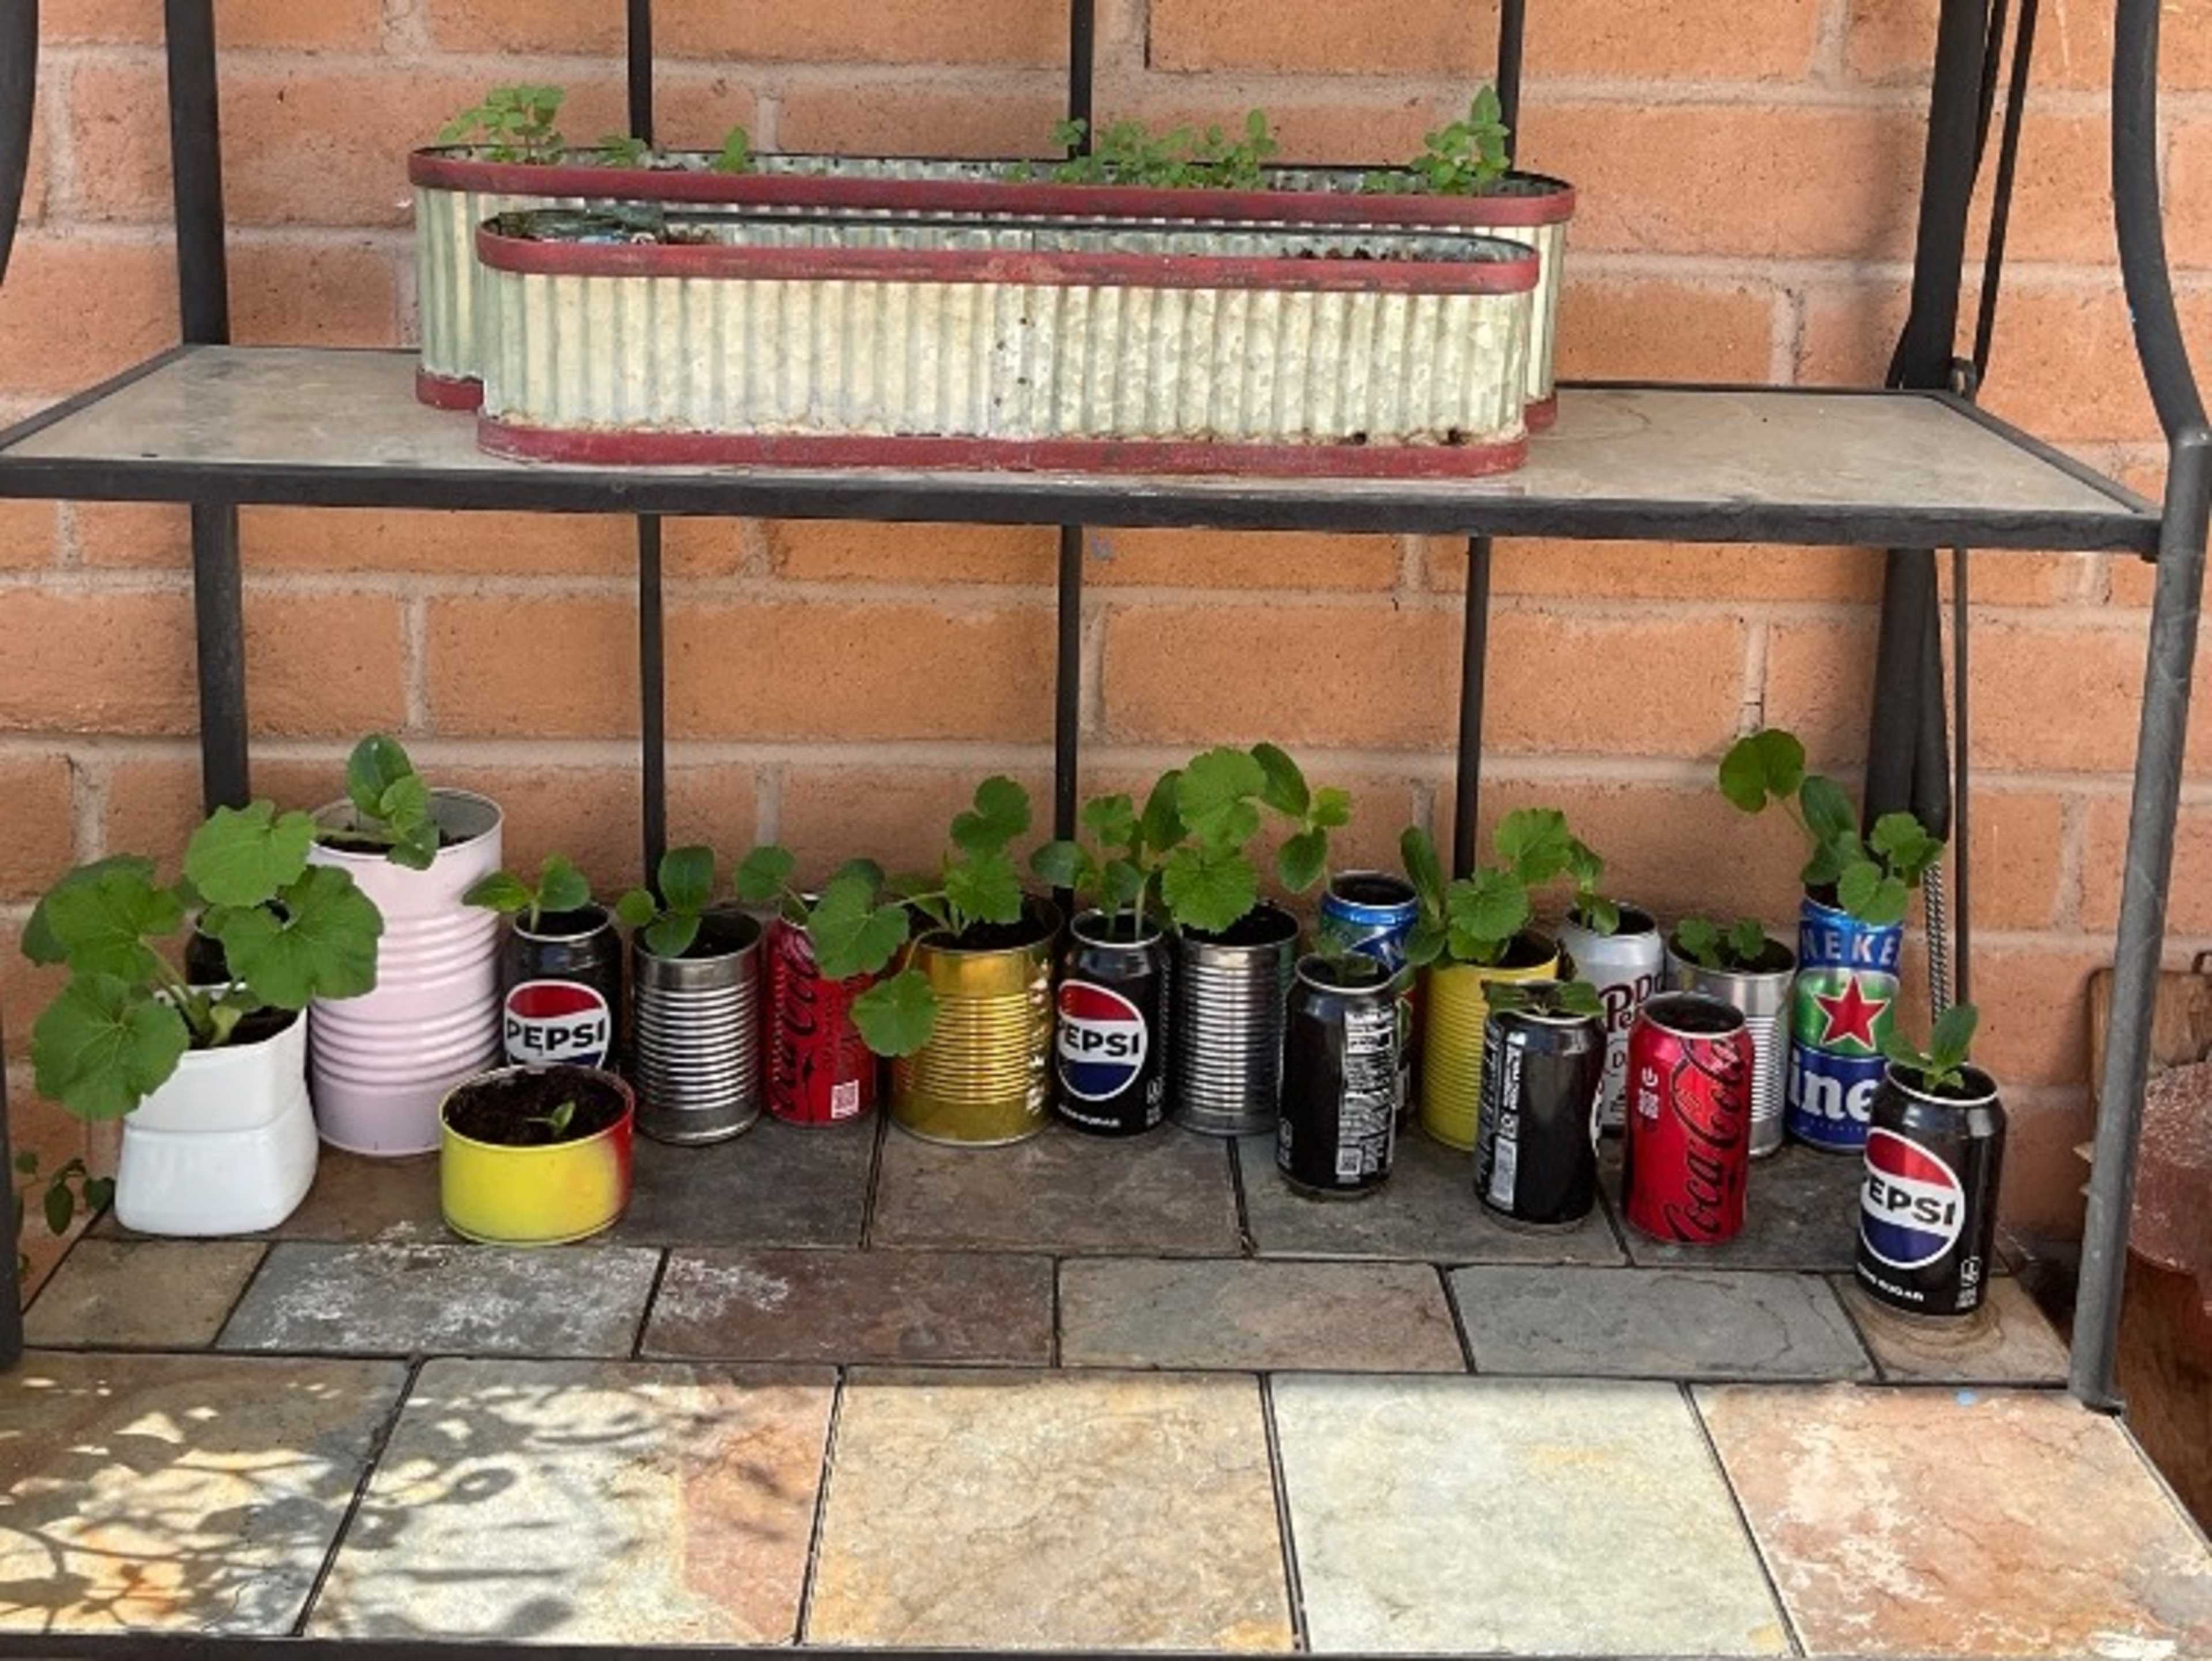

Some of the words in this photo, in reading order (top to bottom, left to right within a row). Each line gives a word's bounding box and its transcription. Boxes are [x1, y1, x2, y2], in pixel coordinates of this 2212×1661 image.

[1801, 927, 1900, 967] NEKE
[506, 1017, 605, 1051] PEPSI
[1061, 1021, 1139, 1057] EPSI
[1866, 1174, 1956, 1226] EPSI
